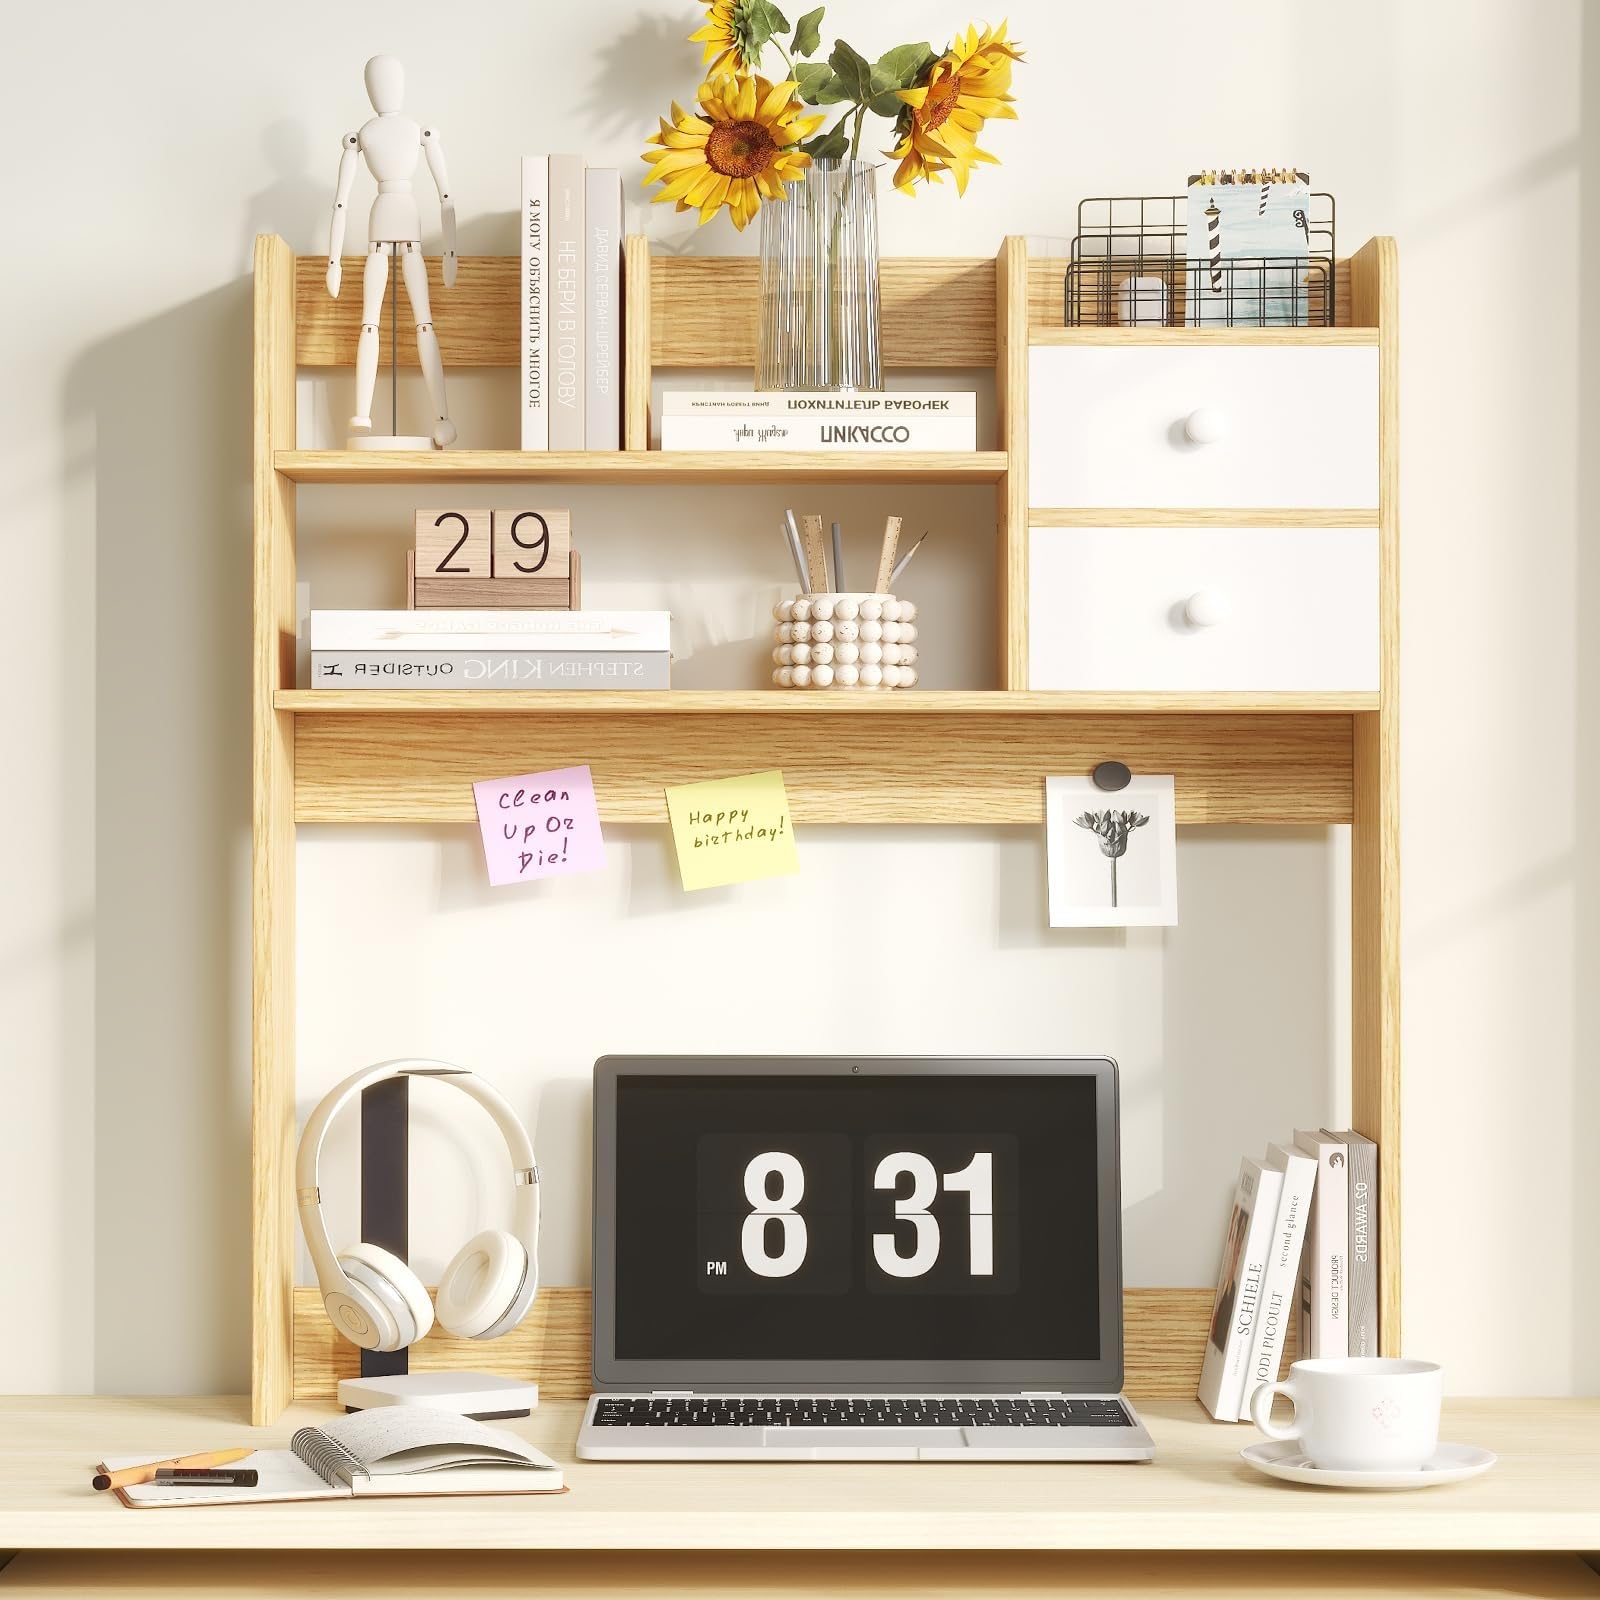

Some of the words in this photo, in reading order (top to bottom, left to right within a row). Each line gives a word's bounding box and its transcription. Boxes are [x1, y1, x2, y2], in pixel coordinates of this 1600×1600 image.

[529, 199, 541, 208] Я
[529, 212, 541, 251] МОГУ
[593, 225, 609, 272] ДАВИД
[558, 241, 577, 264] НЕ
[529, 257, 541, 343] ОБЪЯСНИТЬ
[558, 268, 577, 314] БЕРИ
[558, 319, 577, 331] В
[529, 348, 541, 408] МНОГОЕ
[558, 337, 577, 408] ГОЛОВУ
[499, 789, 569, 809] Clean
[504, 823, 536, 843] Up
[689, 808, 749, 826] Happy
[694, 815, 785, 848] birthday!
[518, 837, 568, 874] Die!
[741, 1151, 808, 1278] 8
[872, 1151, 994, 1278] 31
[1285, 1195, 1299, 1229] glance
[1280, 1232, 1292, 1267] second
[706, 1261, 728, 1276] PM
[1237, 1263, 1262, 1336] SCHIELE
[1263, 1291, 1283, 1348] PICOULT
[1256, 1352, 1272, 1383] JODI
